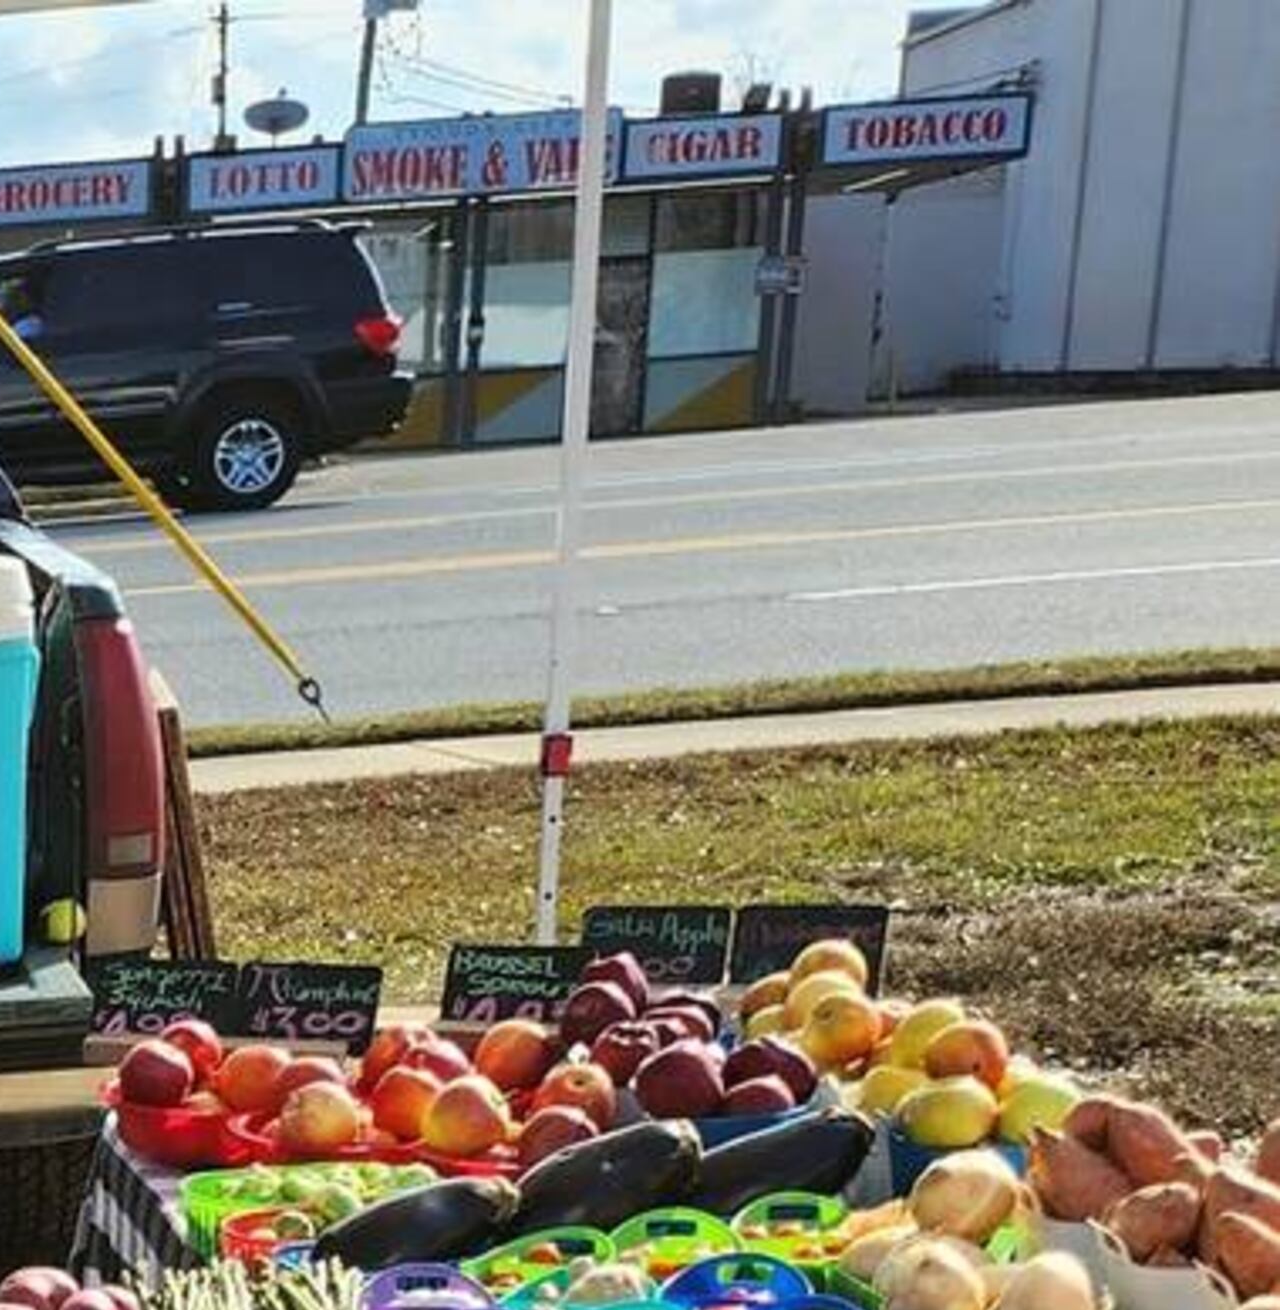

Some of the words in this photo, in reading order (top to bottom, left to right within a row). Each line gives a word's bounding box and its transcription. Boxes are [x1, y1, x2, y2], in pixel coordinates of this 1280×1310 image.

[648, 127, 762, 163] CIGAR
[843, 108, 1008, 151] TOBACCO
[208, 160, 319, 201] LOTTO
[351, 143, 469, 195] SMOKE
[480, 139, 508, 187] &
